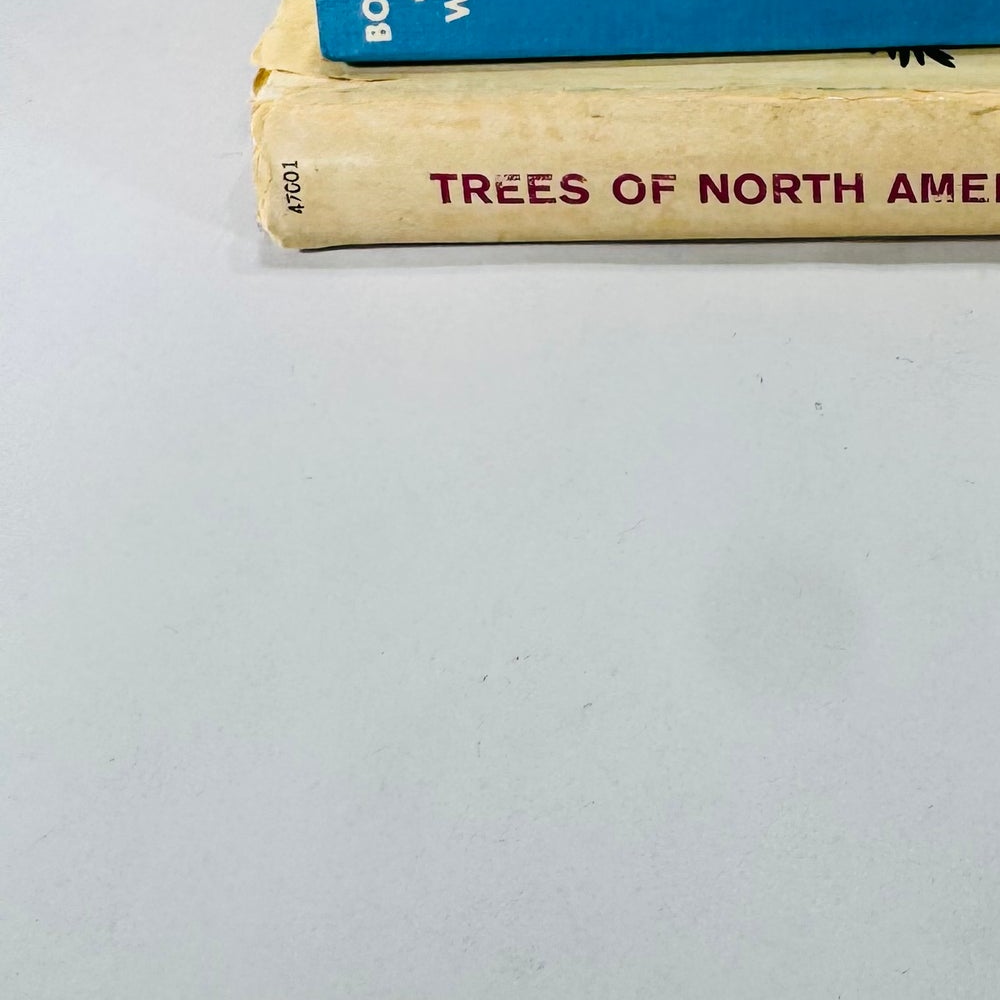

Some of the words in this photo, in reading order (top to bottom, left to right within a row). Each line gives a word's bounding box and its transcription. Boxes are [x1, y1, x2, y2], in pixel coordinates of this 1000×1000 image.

[429, 173, 590, 205] TREES
[612, 173, 677, 205] OF
[699, 173, 865, 205] NORTH
